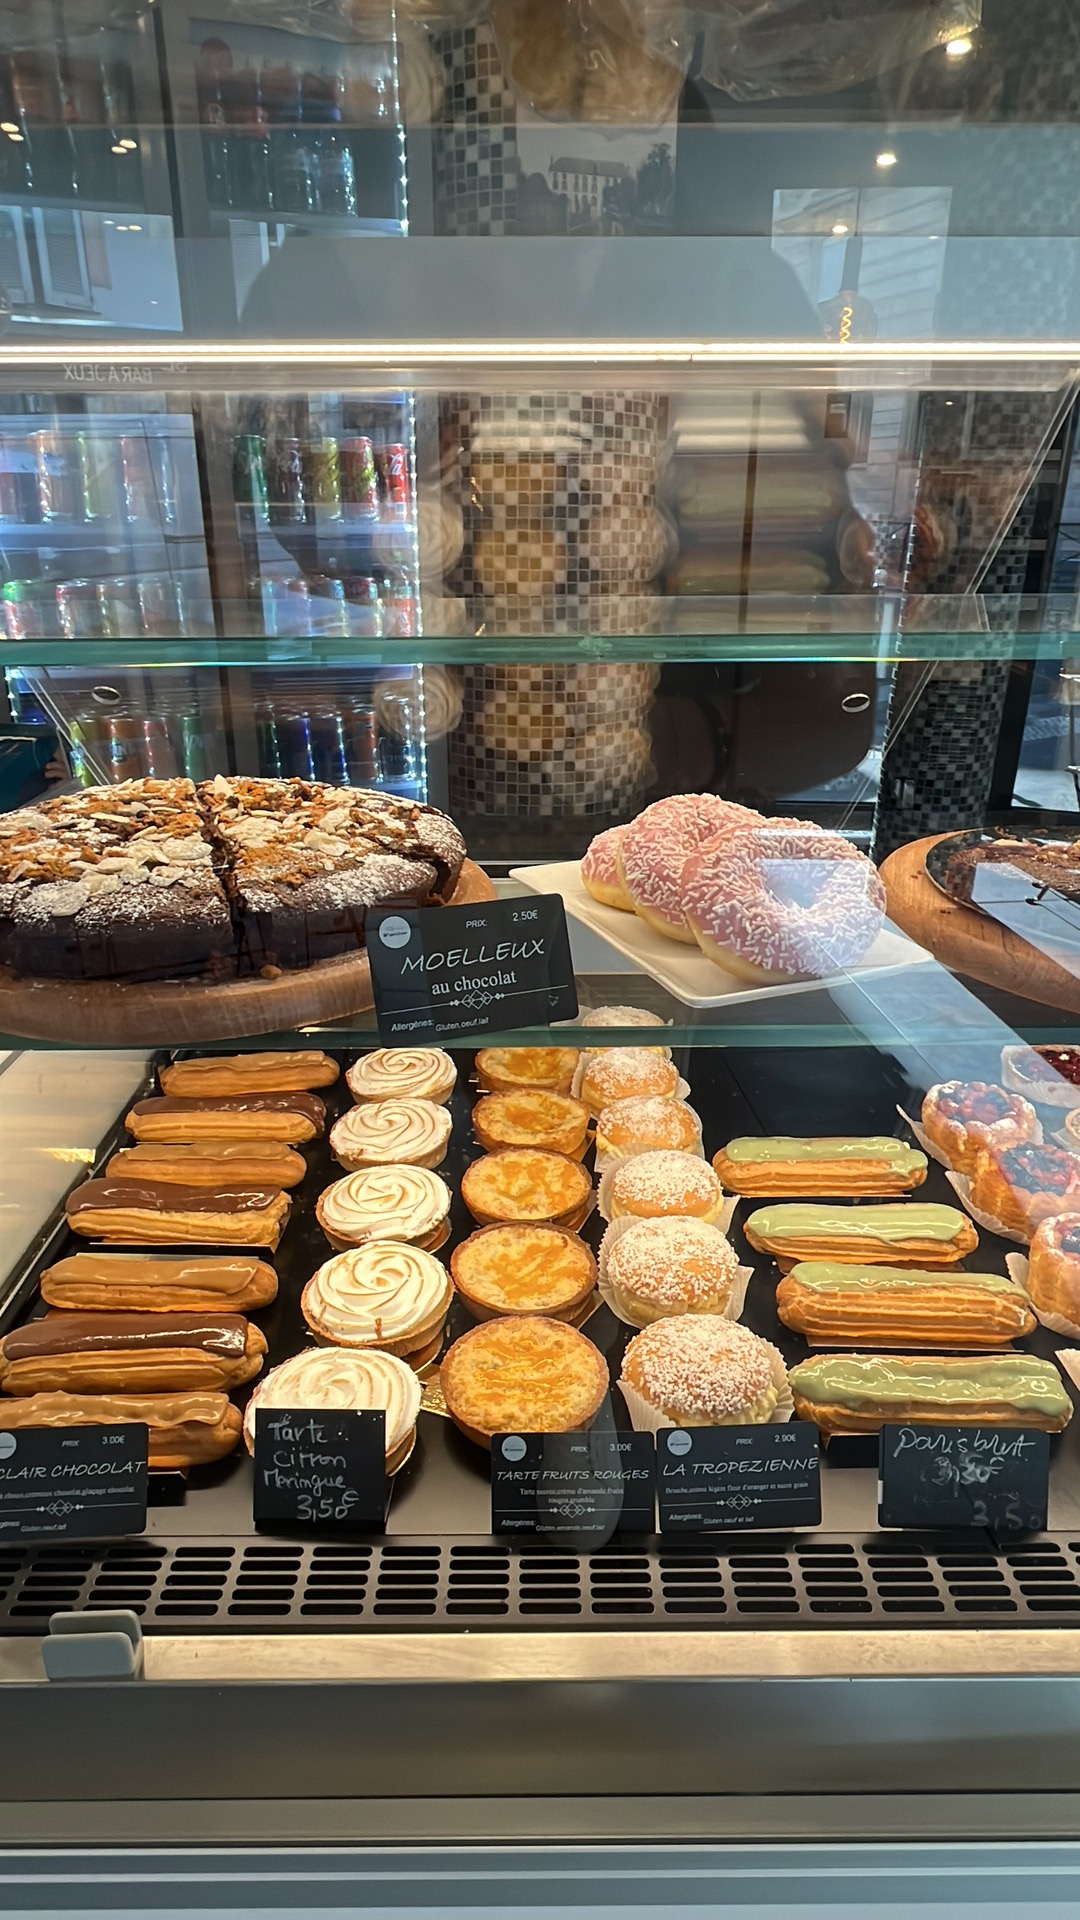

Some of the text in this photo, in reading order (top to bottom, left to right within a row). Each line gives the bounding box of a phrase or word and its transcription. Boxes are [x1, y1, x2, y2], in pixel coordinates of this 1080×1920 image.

[512, 909, 539, 922] 2.50€
[400, 938, 545, 975] MOELLEUX
[431, 970, 517, 996] au chocolat
[267, 1416, 328, 1443] Tarte
[273, 1446, 346, 1468] Citron
[609, 1442, 633, 1452] 3.00€
[51, 1461, 146, 1478] CHOCOLAT
[497, 1469, 649, 1481] TARTE FRUITS ROUGES
[663, 1457, 819, 1476] LA TROPEZIENNE
[297, 1490, 360, 1522] 3,50€
